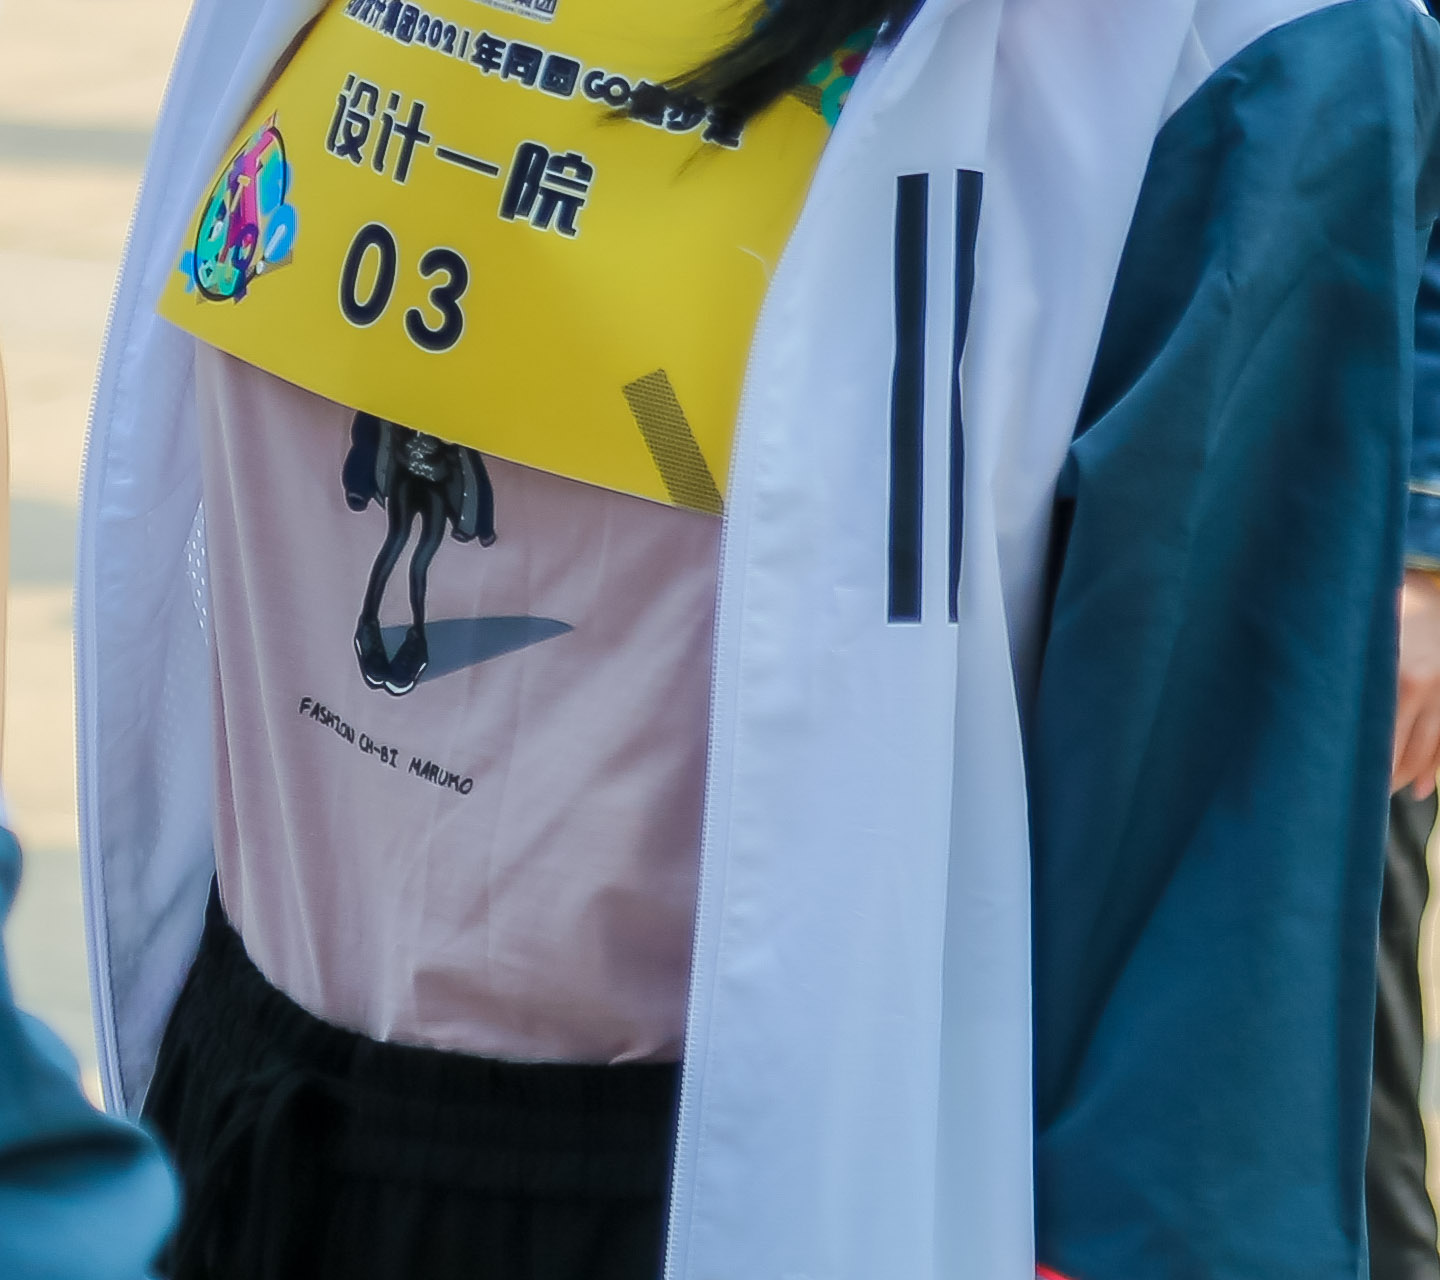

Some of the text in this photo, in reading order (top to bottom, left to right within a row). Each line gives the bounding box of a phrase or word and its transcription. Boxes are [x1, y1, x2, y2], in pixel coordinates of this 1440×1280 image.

[325, 75, 594, 237] 设计一院
[339, 223, 471, 352] 03
[299, 696, 356, 746] FASHION
[408, 754, 475, 796] MARUKO
